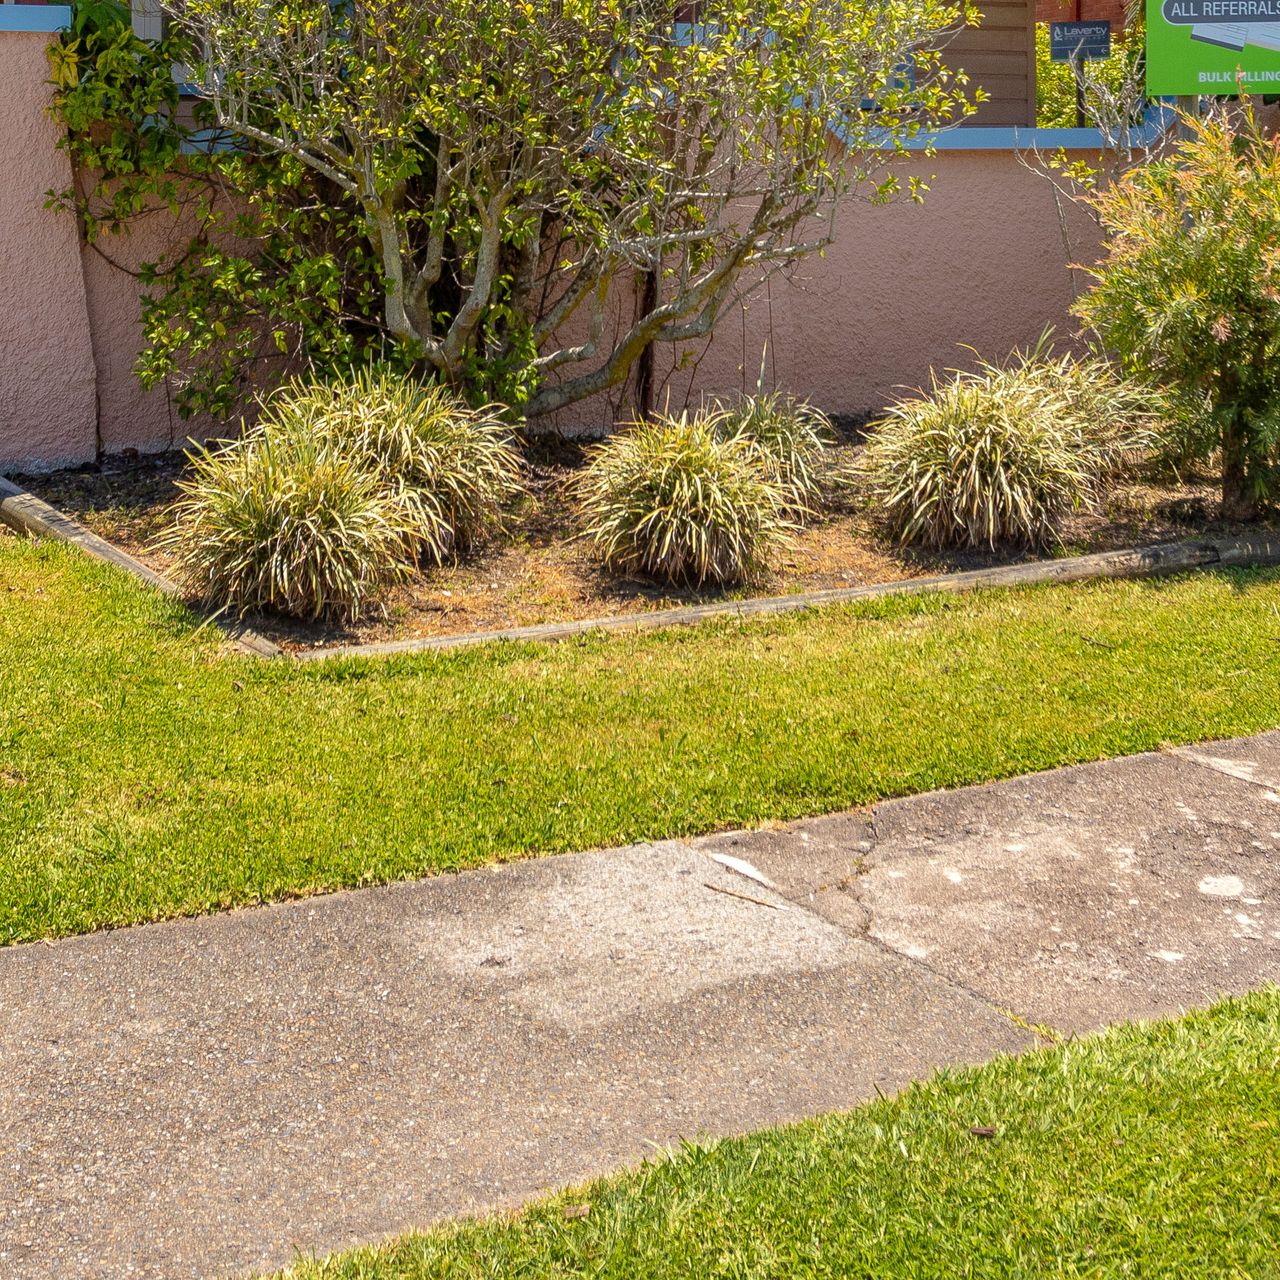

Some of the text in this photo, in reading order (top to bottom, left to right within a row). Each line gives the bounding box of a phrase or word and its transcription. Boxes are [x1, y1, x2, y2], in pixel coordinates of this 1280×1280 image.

[1171, 1, 1198, 17] ALL
[1064, 26, 1107, 36] Laverty
[1198, 71, 1231, 82] BULK
